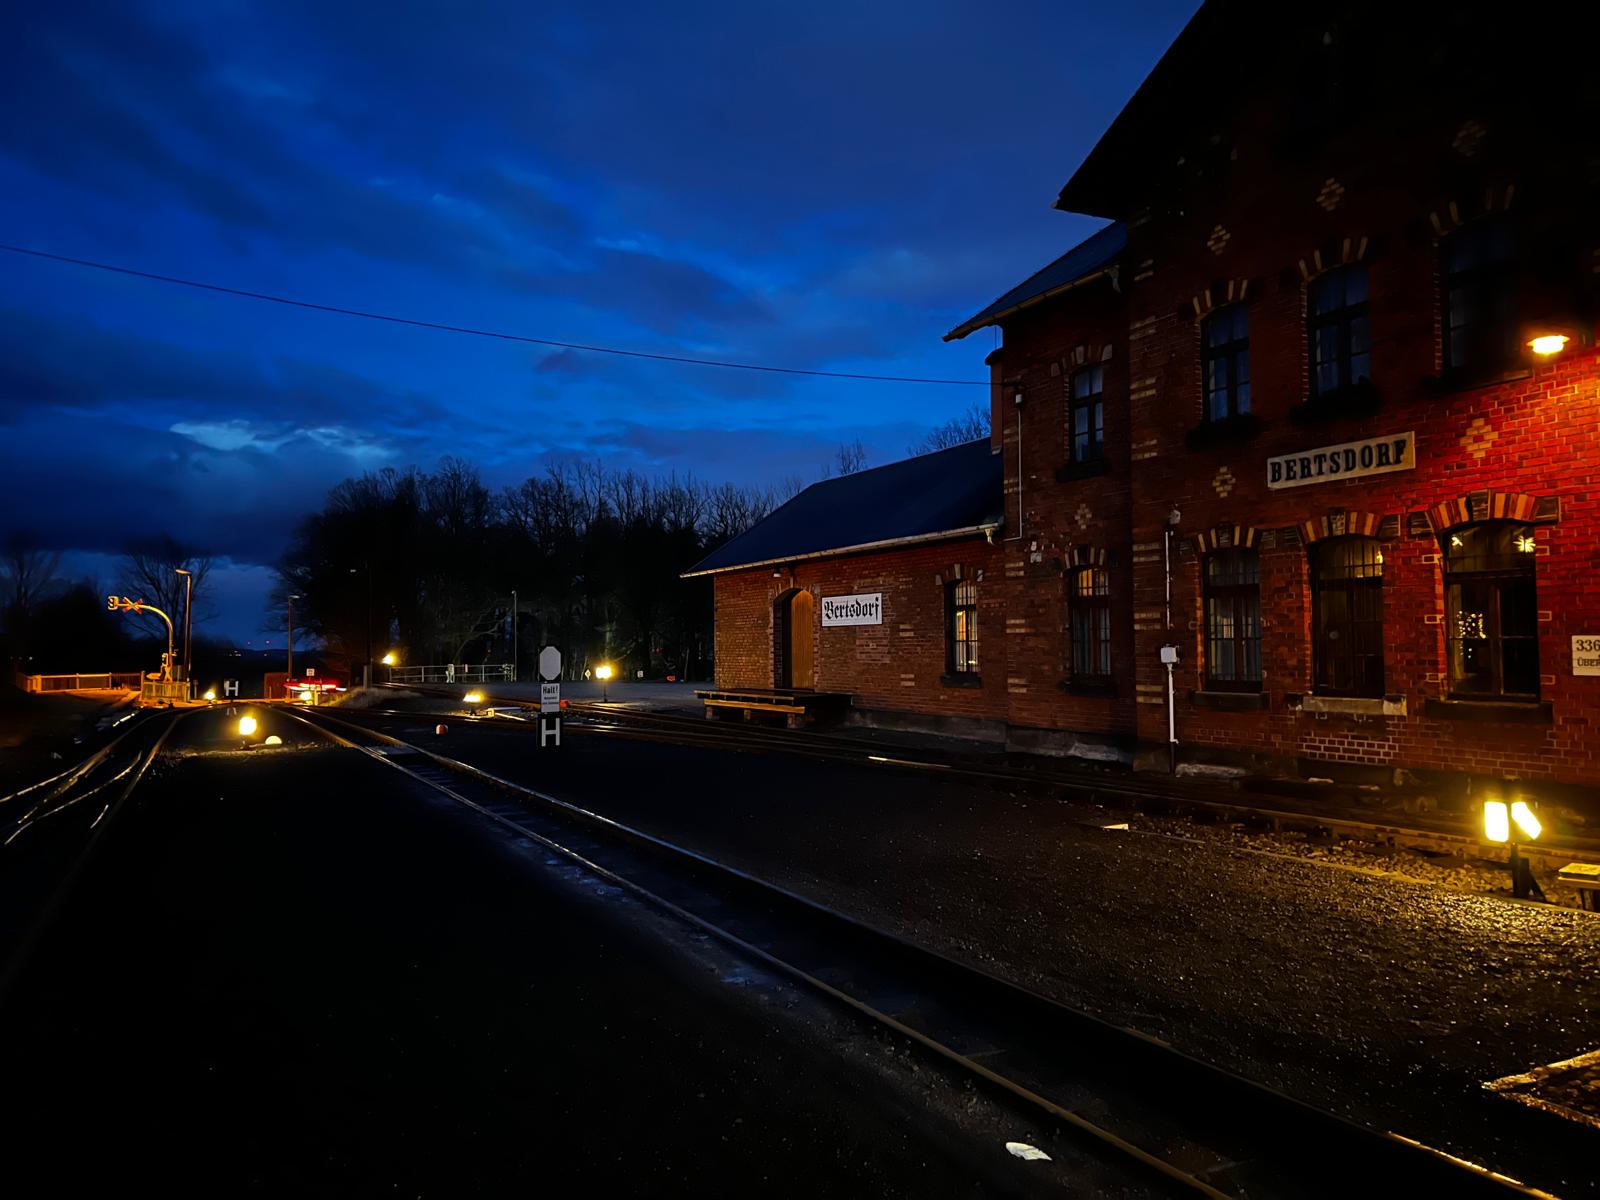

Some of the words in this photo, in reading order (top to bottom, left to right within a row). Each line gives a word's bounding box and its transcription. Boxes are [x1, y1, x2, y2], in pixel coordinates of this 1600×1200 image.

[1270, 439, 1407, 483] BERTSDORF
[824, 596, 879, 621] Bertsdorf
[225, 680, 239, 697] H
[541, 717, 560, 747] H
